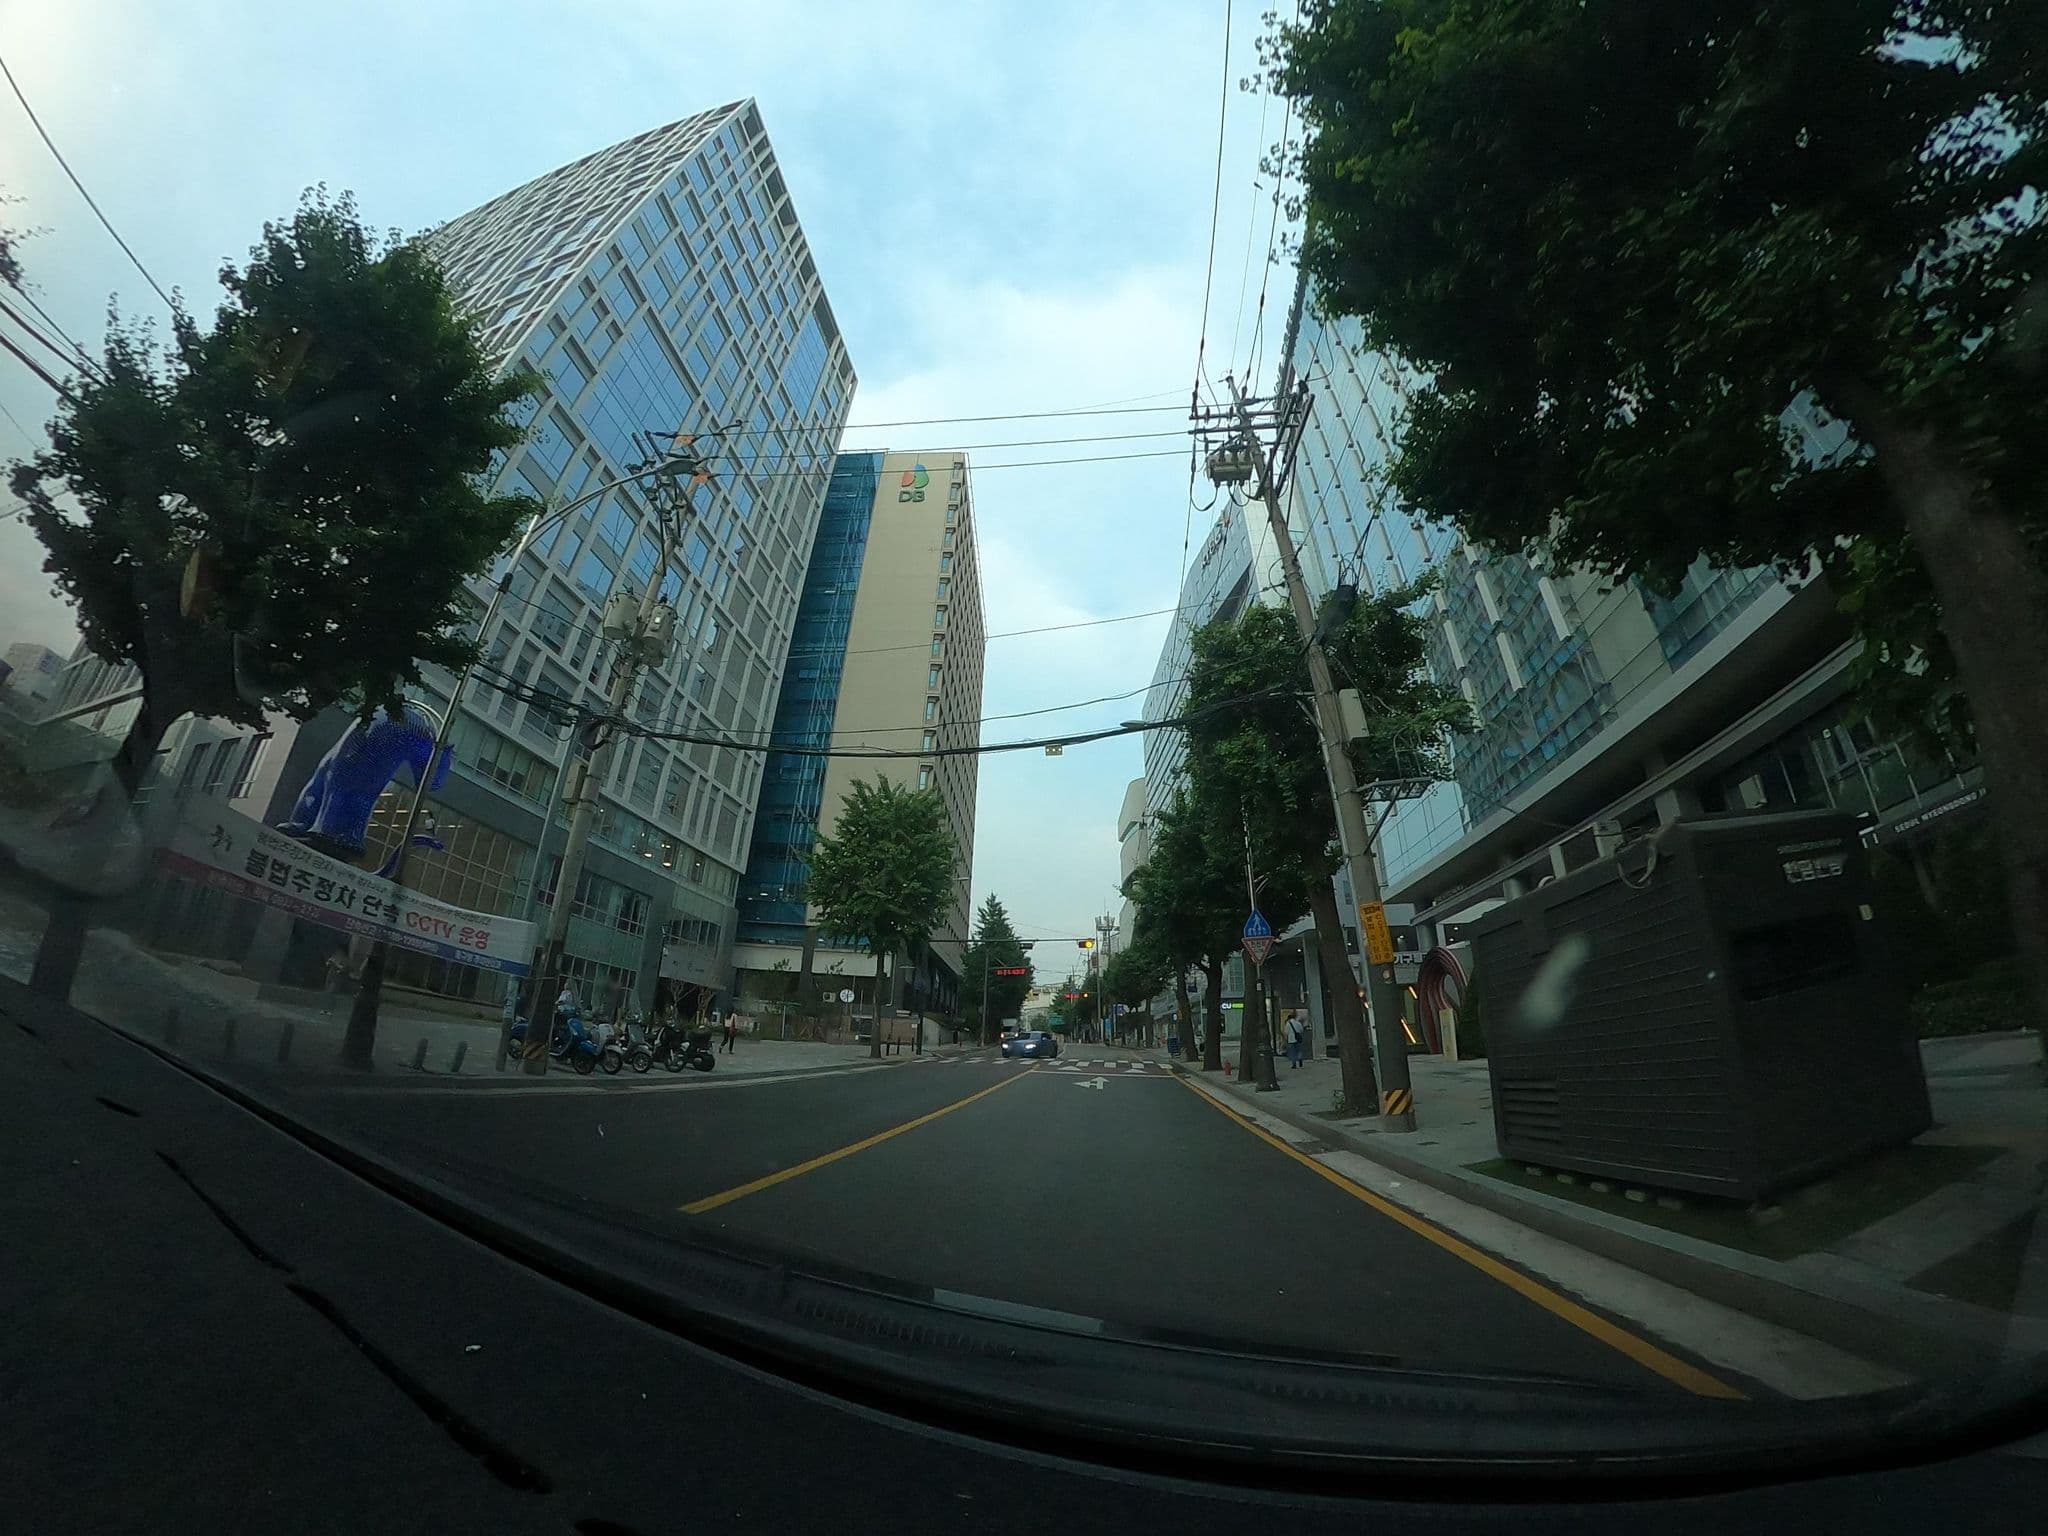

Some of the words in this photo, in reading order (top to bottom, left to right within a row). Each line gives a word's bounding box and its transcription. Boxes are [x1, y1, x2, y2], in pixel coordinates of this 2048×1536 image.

[899, 490, 925, 503] DB
[1894, 818, 1921, 833] SEOUL
[245, 848, 357, 909] 불법주정차
[362, 894, 400, 924] 단속
[406, 911, 456, 939] CCTV
[459, 925, 491, 951] 운영
